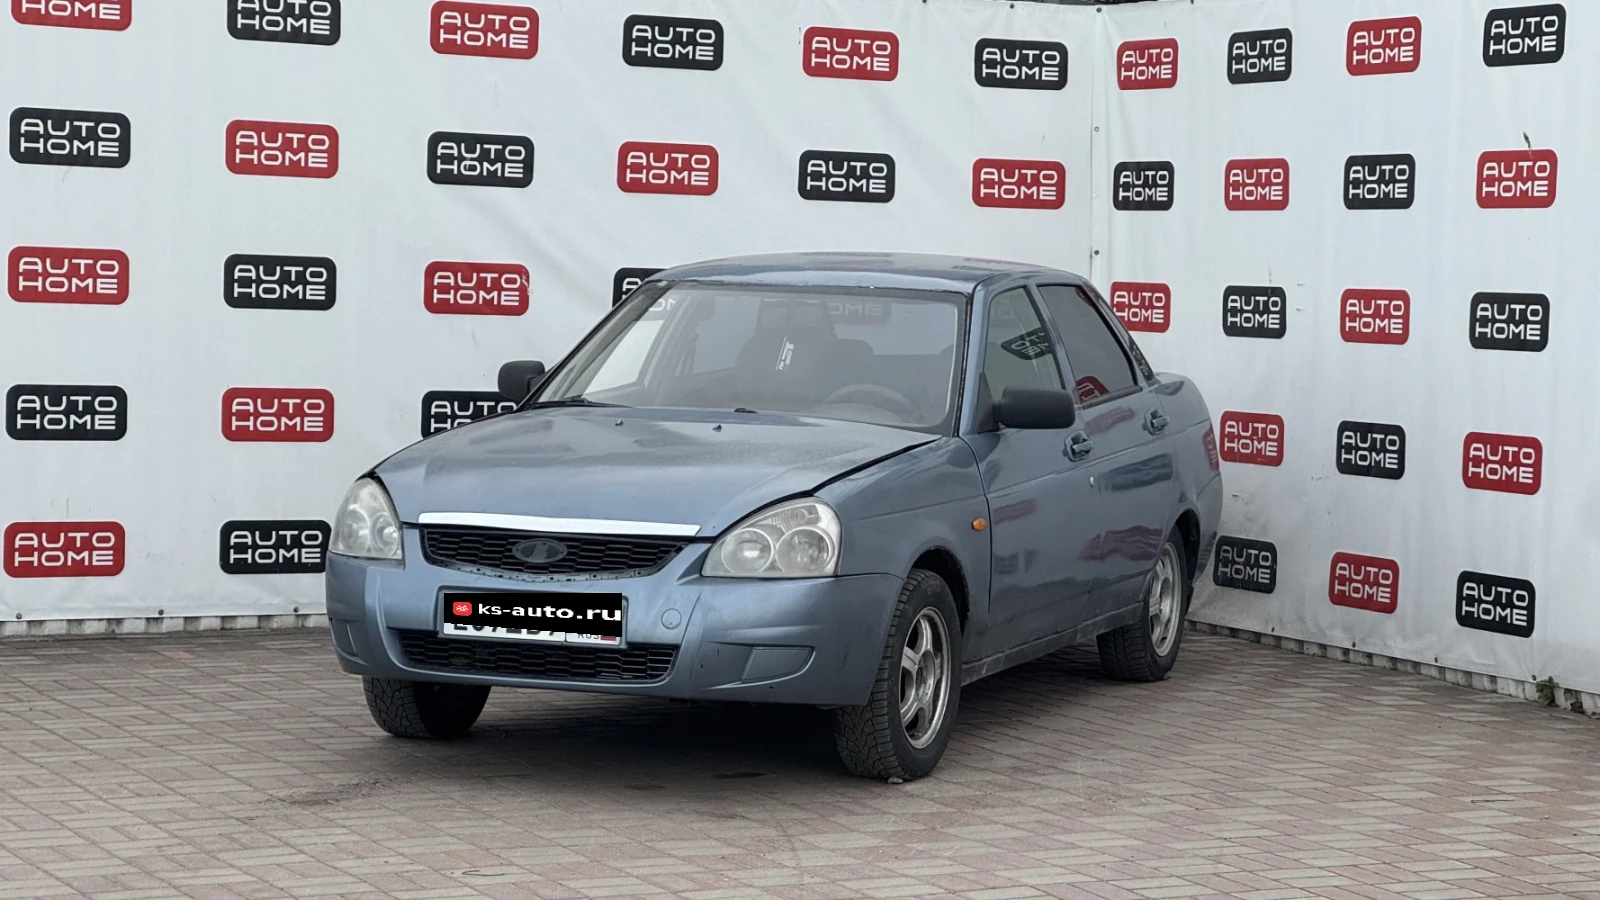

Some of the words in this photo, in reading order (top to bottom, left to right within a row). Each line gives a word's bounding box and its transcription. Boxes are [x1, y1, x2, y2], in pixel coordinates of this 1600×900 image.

[22, 0, 120, 20] HOME
[237, 0, 332, 17] AUTO
[237, 13, 330, 35] HOME
[440, 11, 530, 31] AUTO
[1491, 16, 1558, 36] AUTO
[440, 29, 528, 49] HOME
[632, 25, 715, 43] AUTO
[1353, 28, 1415, 47] AUTO
[632, 42, 714, 60] HOME
[812, 37, 891, 55] AUTO
[1233, 39, 1287, 56] AUTO
[1489, 35, 1556, 55] HOME
[811, 53, 889, 71] HOME
[983, 48, 1060, 64] AUTO
[1122, 48, 1173, 64] AUTO
[1353, 46, 1413, 65] HOME
[983, 64, 1059, 80] HOME
[1121, 65, 1172, 80] HOME
[1232, 56, 1285, 73] HOME
[21, 119, 120, 138] AUTO
[21, 137, 119, 157] HOME
[236, 131, 329, 149] AUTO
[236, 149, 328, 168] HOME
[437, 142, 525, 160] AUTO
[437, 159, 523, 177] HOME
[627, 152, 710, 168] AUTO
[808, 160, 887, 176] AUTO
[626, 169, 709, 185] HOME
[981, 168, 1057, 183] AUTO
[1120, 171, 1169, 184] AUTO
[1230, 168, 1283, 183] AUTO
[1350, 165, 1409, 180] AUTO
[1483, 161, 1550, 178] AUTO
[807, 177, 886, 193] HOME
[981, 184, 1056, 200] HOME
[1119, 187, 1168, 200] HOME
[1230, 186, 1282, 200] HOME
[1349, 183, 1407, 198] HOME
[1482, 181, 1548, 197] HOME
[19, 257, 119, 275] AUTO
[234, 265, 327, 282] AUTO
[19, 276, 117, 293] HOME
[434, 272, 522, 288] AUTO
[234, 283, 325, 300] HOME
[434, 289, 519, 305] HOME
[1113, 291, 1166, 306] AUTO
[1228, 296, 1281, 311] AUTO
[1346, 299, 1404, 315] AUTO
[1477, 303, 1542, 320] AUTO
[1113, 307, 1165, 323] HOME
[1228, 313, 1280, 328] HOME
[1346, 317, 1403, 333] HOME
[1476, 322, 1541, 340] HOME
[17, 396, 117, 411] AUTO
[232, 398, 324, 413] AUTO
[430, 401, 517, 415] AUTO
[17, 414, 115, 429] HOME
[232, 416, 323, 431] HOME
[1225, 421, 1278, 438] AUTO
[1225, 438, 1277, 456] HOME
[1342, 432, 1399, 450] AUTO
[1342, 449, 1398, 468] HOME
[1470, 443, 1535, 464] AUTO
[1469, 462, 1533, 483] HOME
[15, 532, 115, 548] AUTO
[230, 531, 322, 545] AUTO
[15, 551, 113, 566] HOME
[230, 548, 320, 563] HOME
[1220, 545, 1272, 567] AUTO
[1217, 562, 1271, 584] HOME
[1336, 563, 1392, 584] AUTO
[1335, 581, 1390, 602] HOME
[1463, 582, 1528, 606] AUTO
[1462, 601, 1527, 625] HOME
